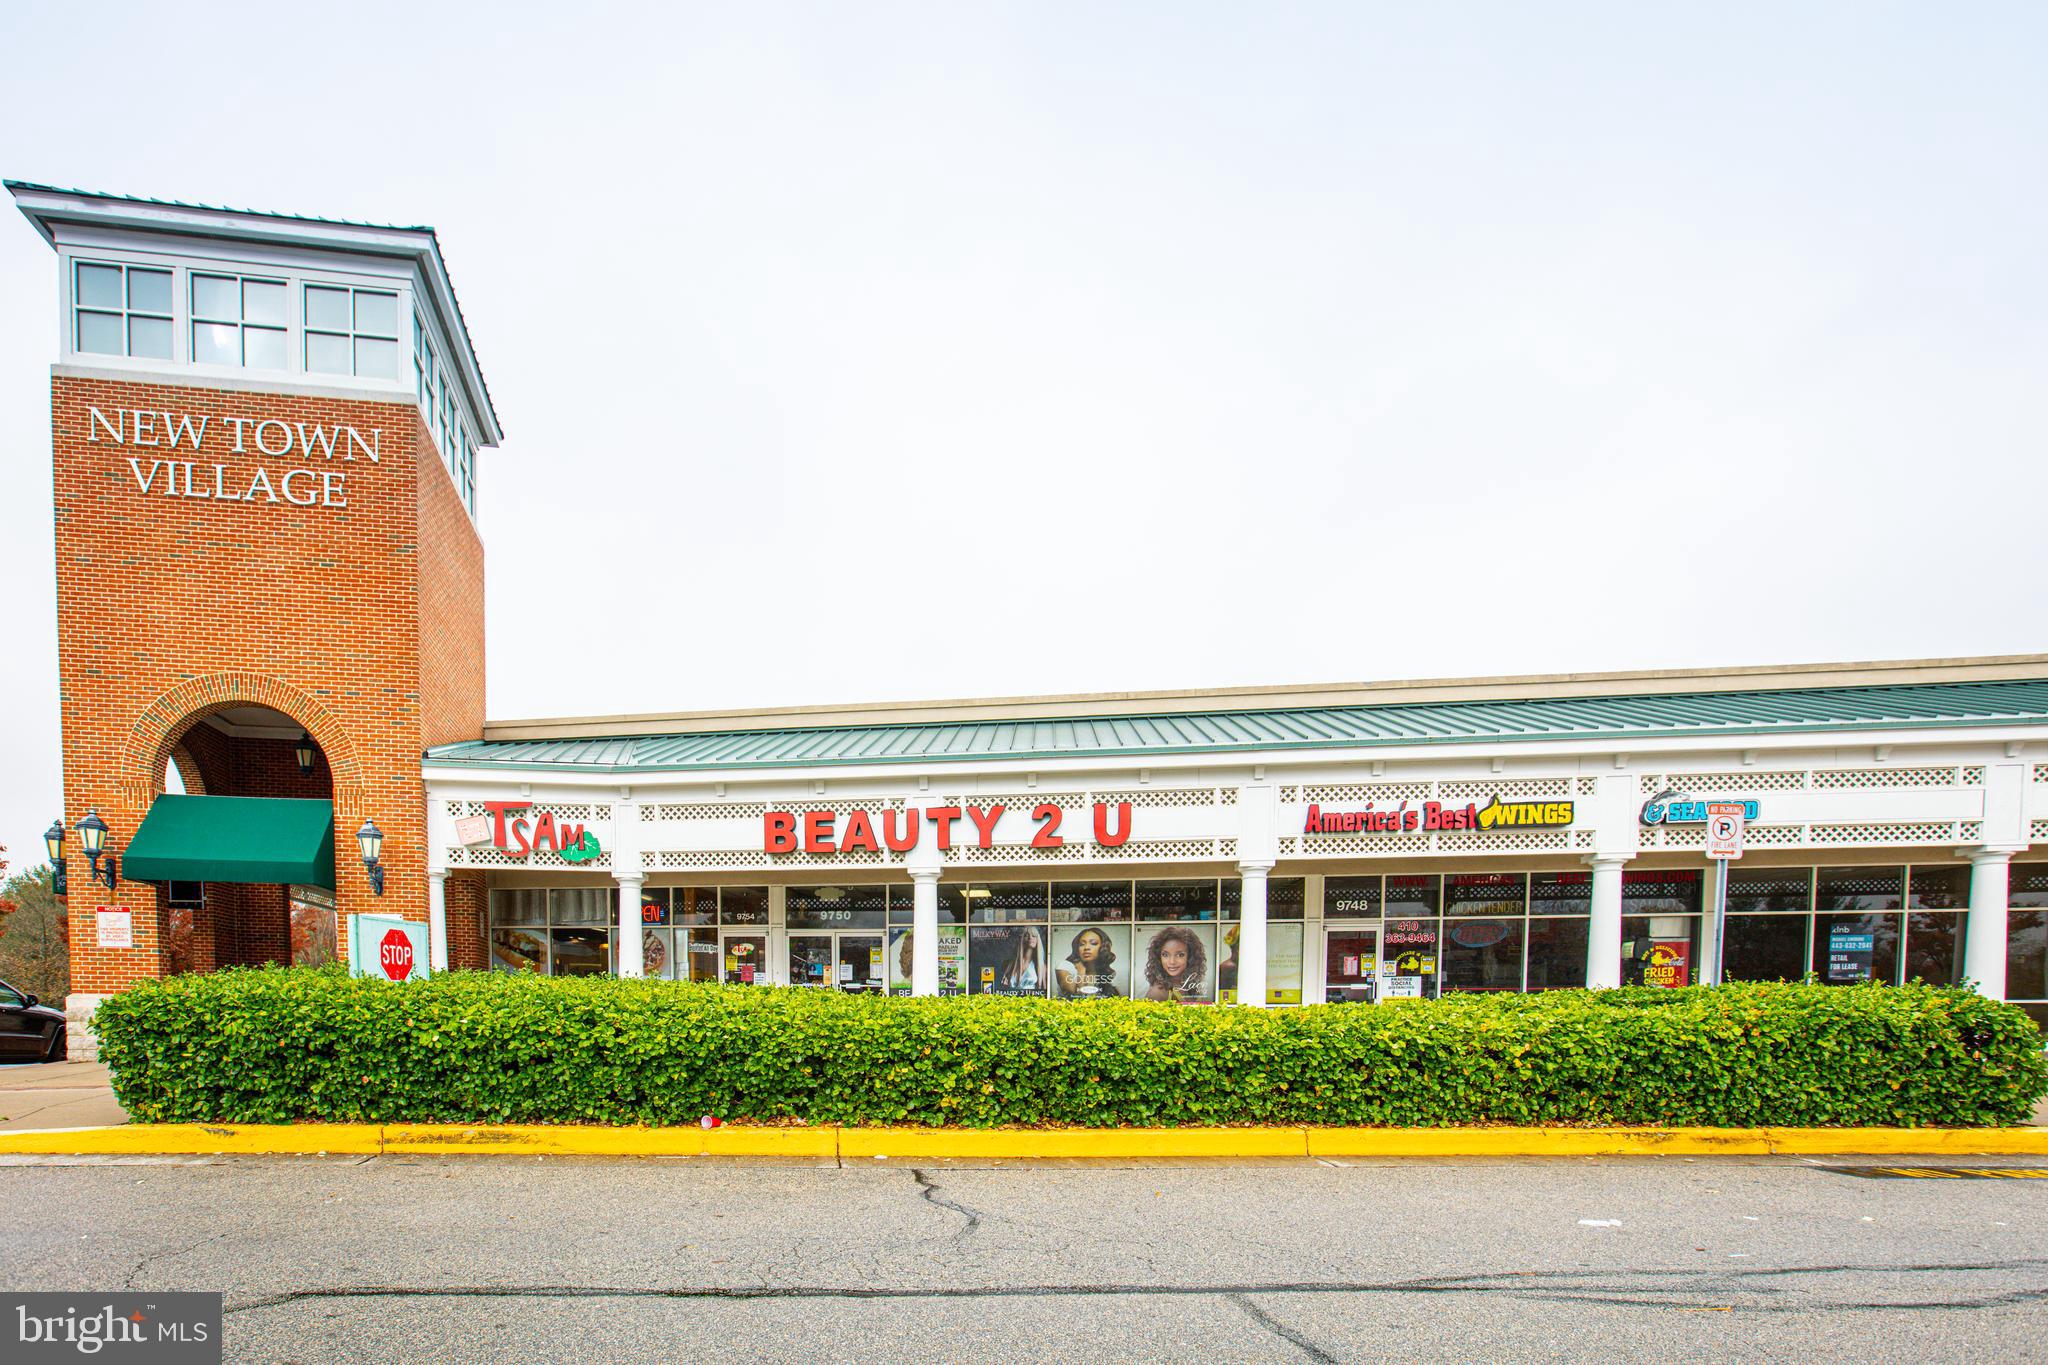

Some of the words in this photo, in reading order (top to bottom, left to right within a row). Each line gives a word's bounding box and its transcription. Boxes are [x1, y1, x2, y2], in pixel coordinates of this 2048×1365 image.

[86, 406, 210, 449] NEW
[224, 417, 382, 463] TOWN
[127, 458, 347, 507] VILLAGE
[1304, 800, 1419, 833] America's
[1423, 801, 1477, 831] Best
[1496, 801, 1573, 826] WINGS
[1647, 804, 1664, 822] &
[1668, 801, 1759, 821] SEAD
[764, 805, 1006, 853] BEAUTY
[1031, 803, 1063, 848] 2
[1093, 802, 1131, 848] U
[642, 905, 660, 922] EN
[1336, 900, 1368, 911] 9748
[737, 912, 754, 921] 9754
[820, 911, 852, 920] 9750
[1398, 921, 1418, 931] 410
[1385, 933, 1436, 944] 363-9464
[382, 945, 412, 965] STOP
[1644, 967, 1675, 978] FRIED
